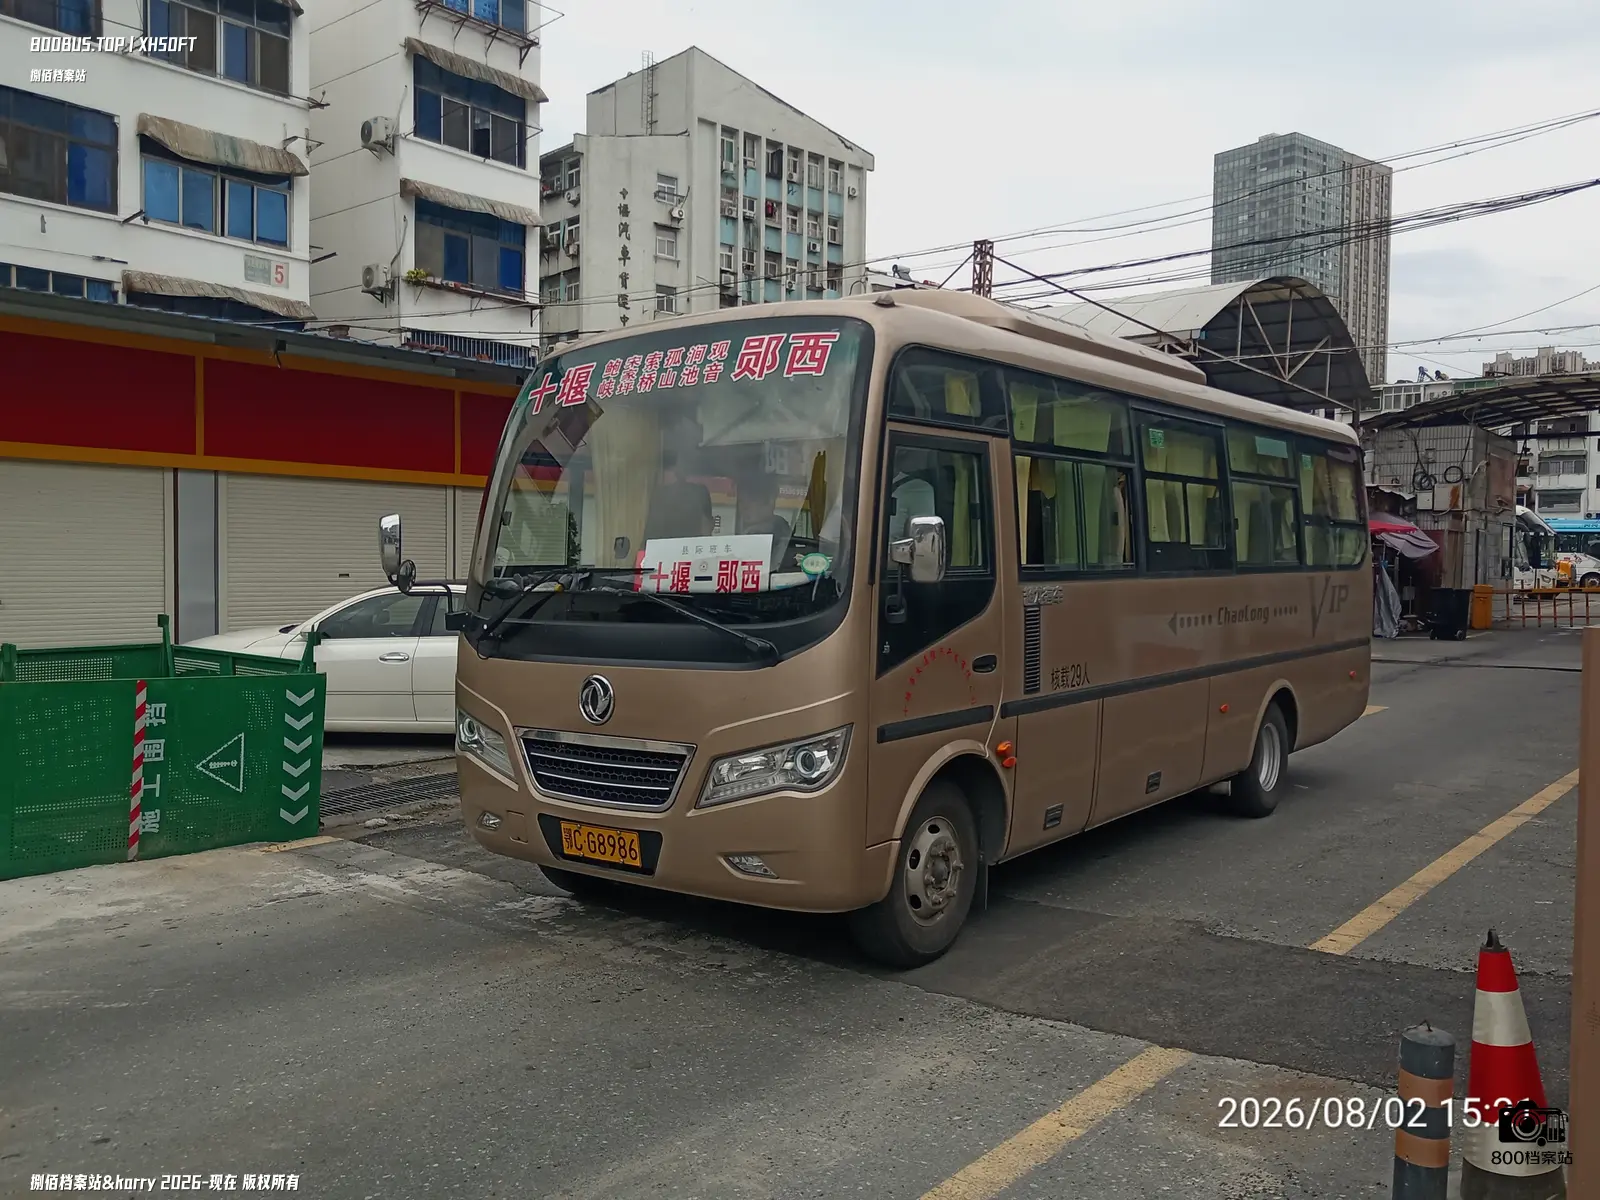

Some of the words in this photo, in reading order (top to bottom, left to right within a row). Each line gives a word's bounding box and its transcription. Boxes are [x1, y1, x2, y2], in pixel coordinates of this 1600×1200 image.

[274, 264, 284, 284] 5
[731, 331, 840, 382] 郧西
[528, 361, 597, 415] 十堰
[1217, 605, 1270, 625] ChaoLong
[1307, 575, 1350, 638] VIP
